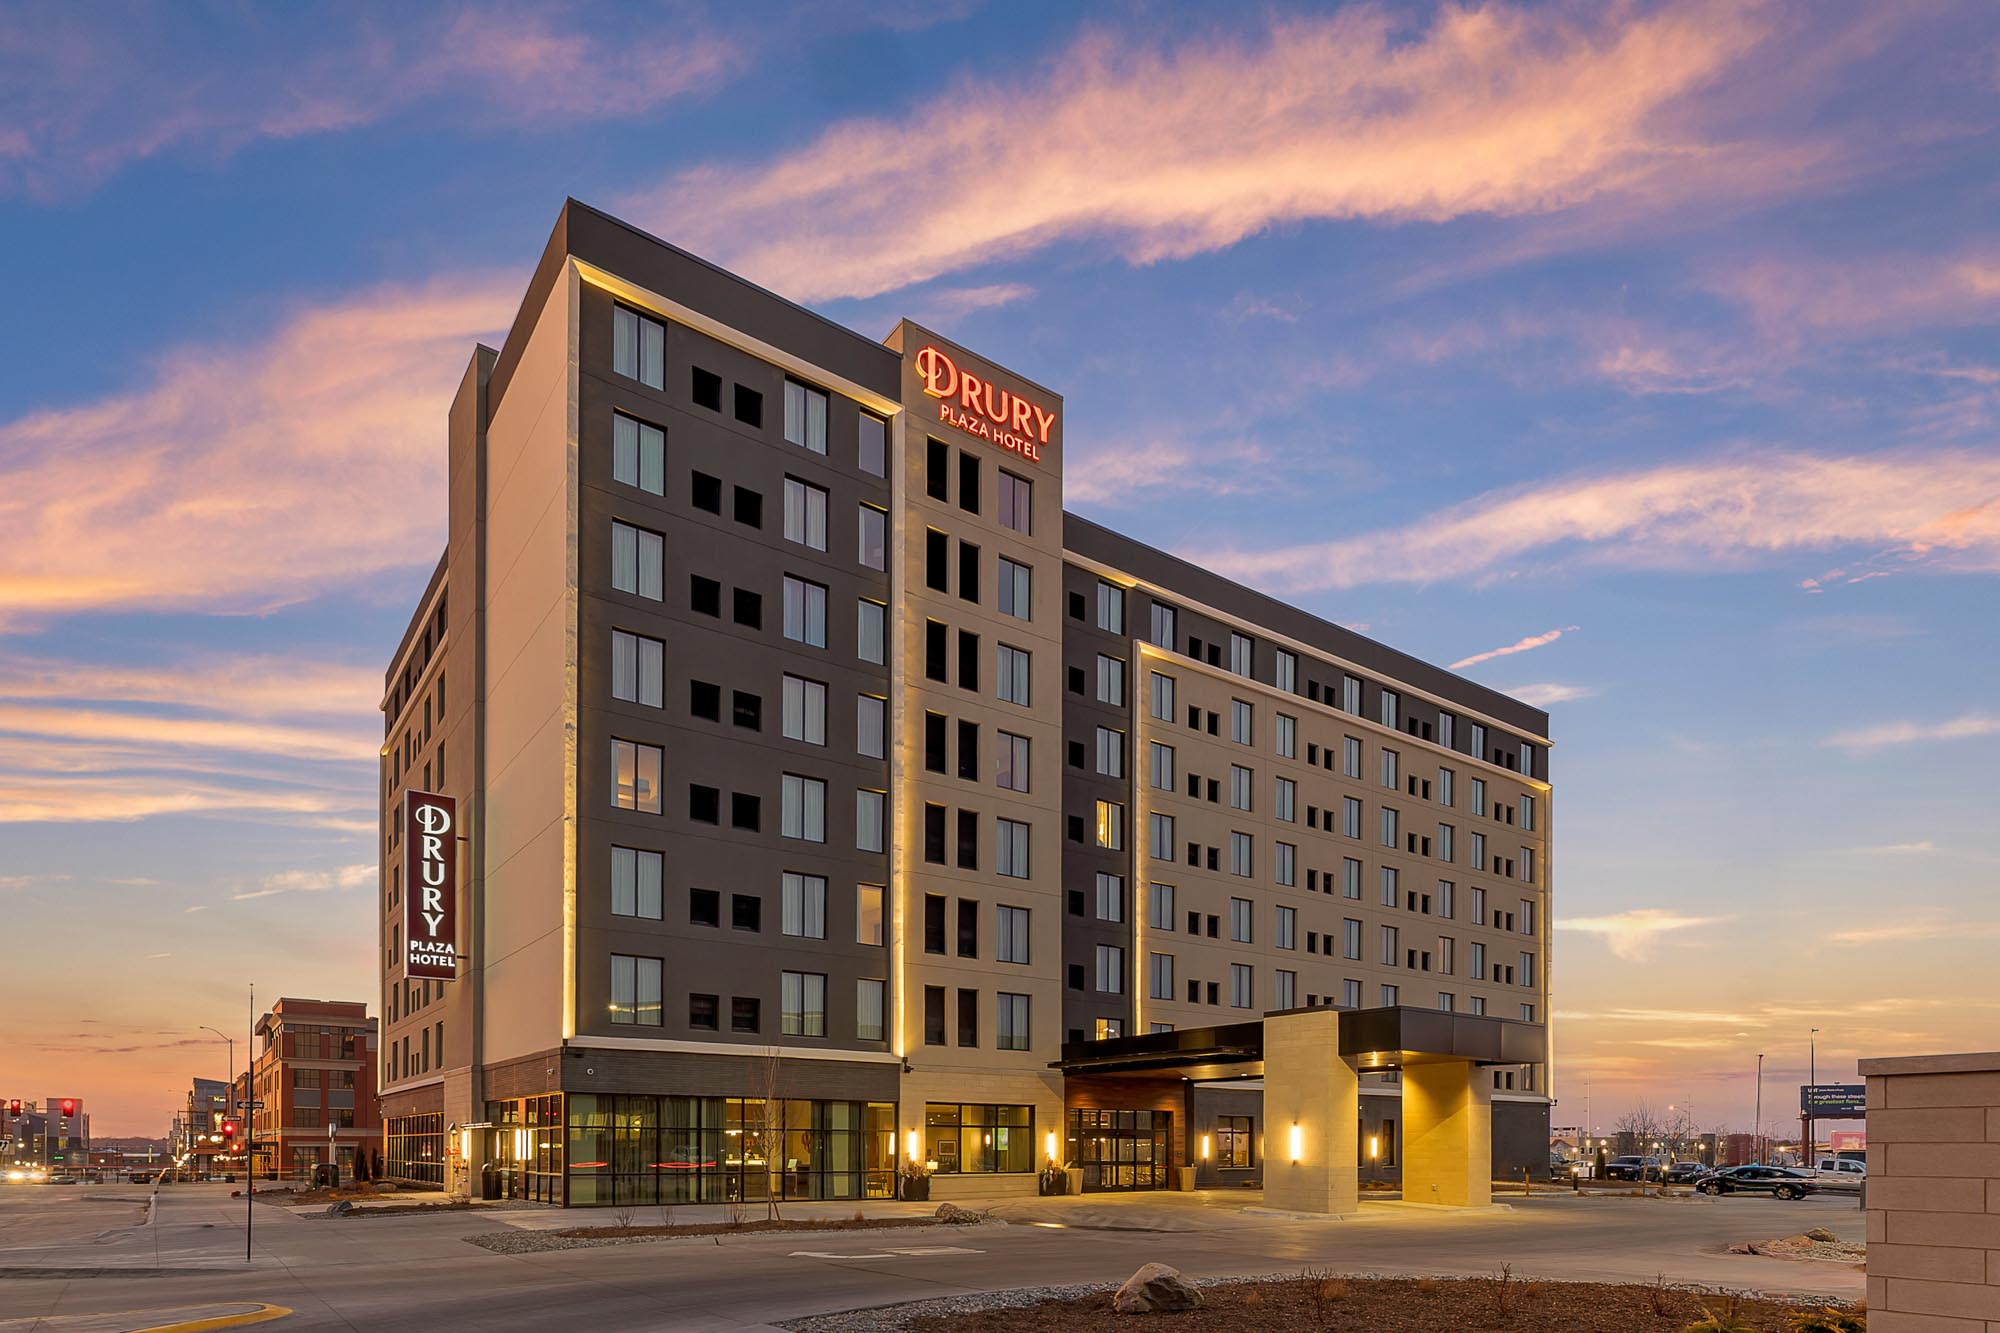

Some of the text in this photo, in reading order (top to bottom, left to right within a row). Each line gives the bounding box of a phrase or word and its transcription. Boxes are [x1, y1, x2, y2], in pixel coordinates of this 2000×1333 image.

[916, 346, 1055, 443] DRURY
[940, 404, 1040, 461] PLAZA HOTEL
[415, 804, 451, 937] DRURY
[410, 940, 455, 954] PLAZA
[410, 953, 456, 967] HOTEL
